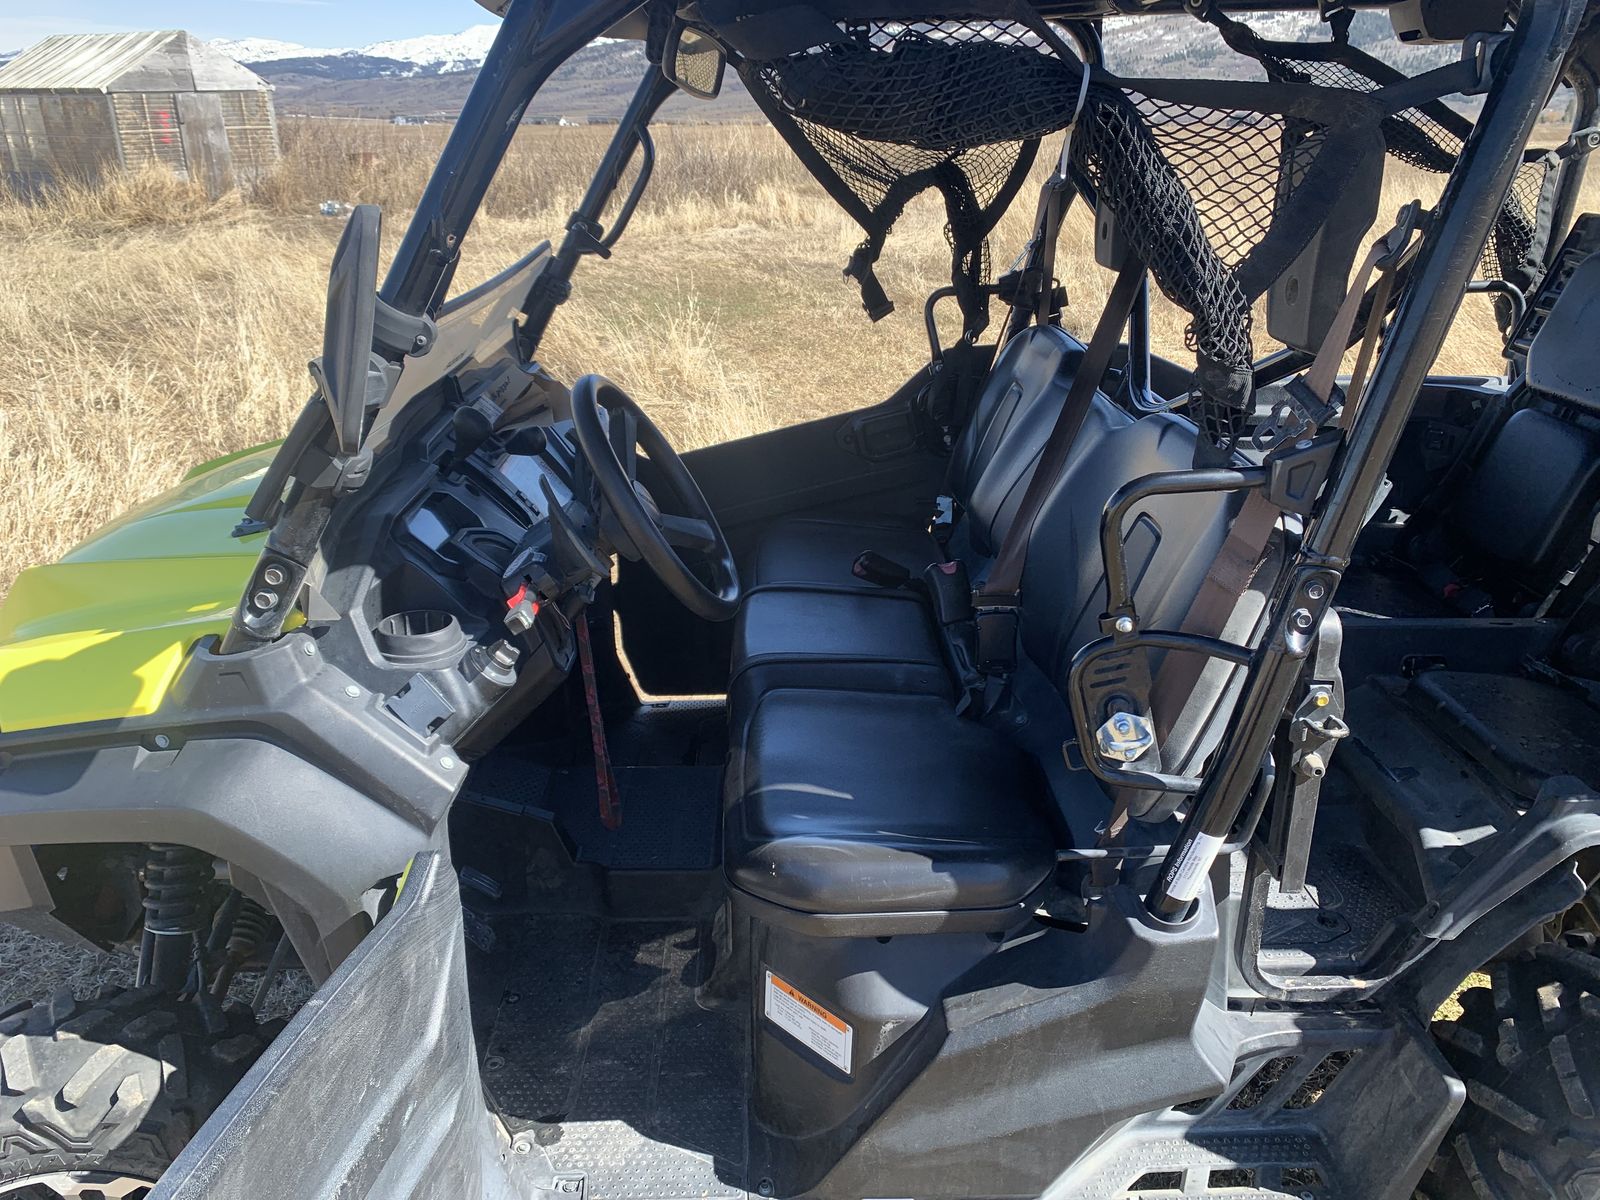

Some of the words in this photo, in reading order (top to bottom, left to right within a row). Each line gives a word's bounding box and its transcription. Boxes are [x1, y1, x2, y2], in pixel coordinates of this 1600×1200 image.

[1166, 866, 1178, 882] ROPS
[1174, 838, 1193, 868] Information
[798, 996, 828, 1019] WARNING
